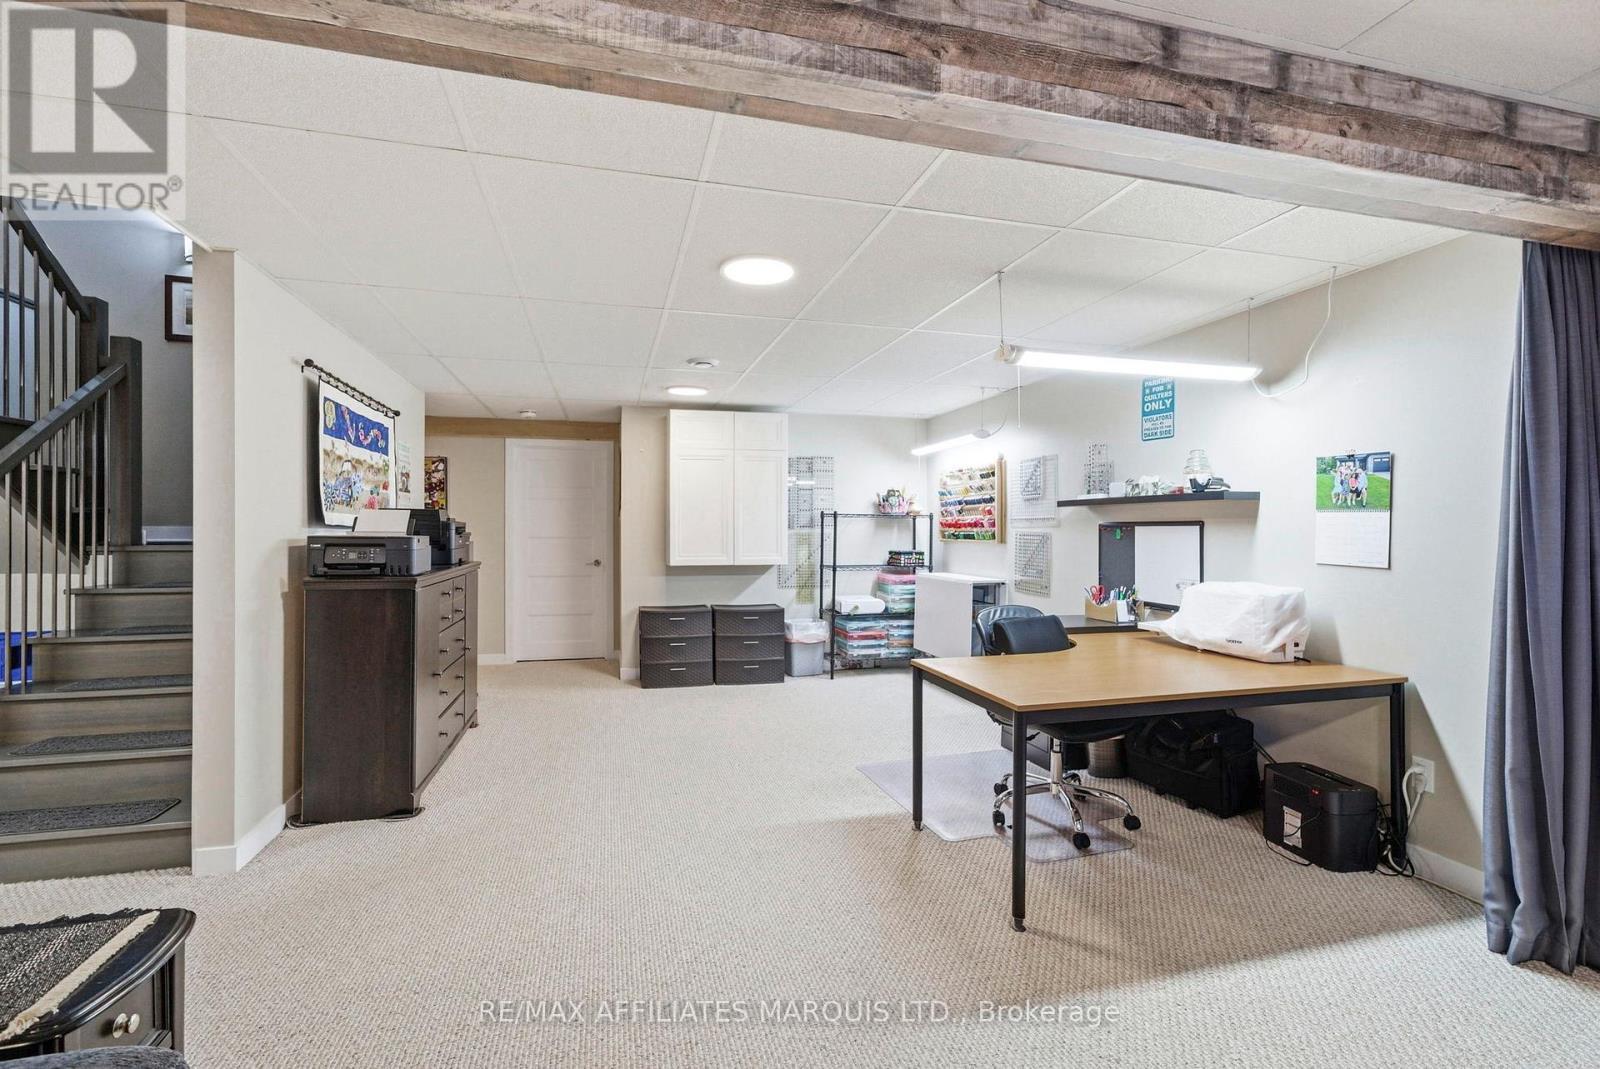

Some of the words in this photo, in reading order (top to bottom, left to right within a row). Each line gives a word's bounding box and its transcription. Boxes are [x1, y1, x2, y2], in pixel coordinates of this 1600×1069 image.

[1144, 391, 1172, 401] QUILTERS
[1144, 398, 1172, 412] ONLY
[1144, 414, 1172, 423] VIOLATORS
[1159, 429, 1172, 437] SIDE
